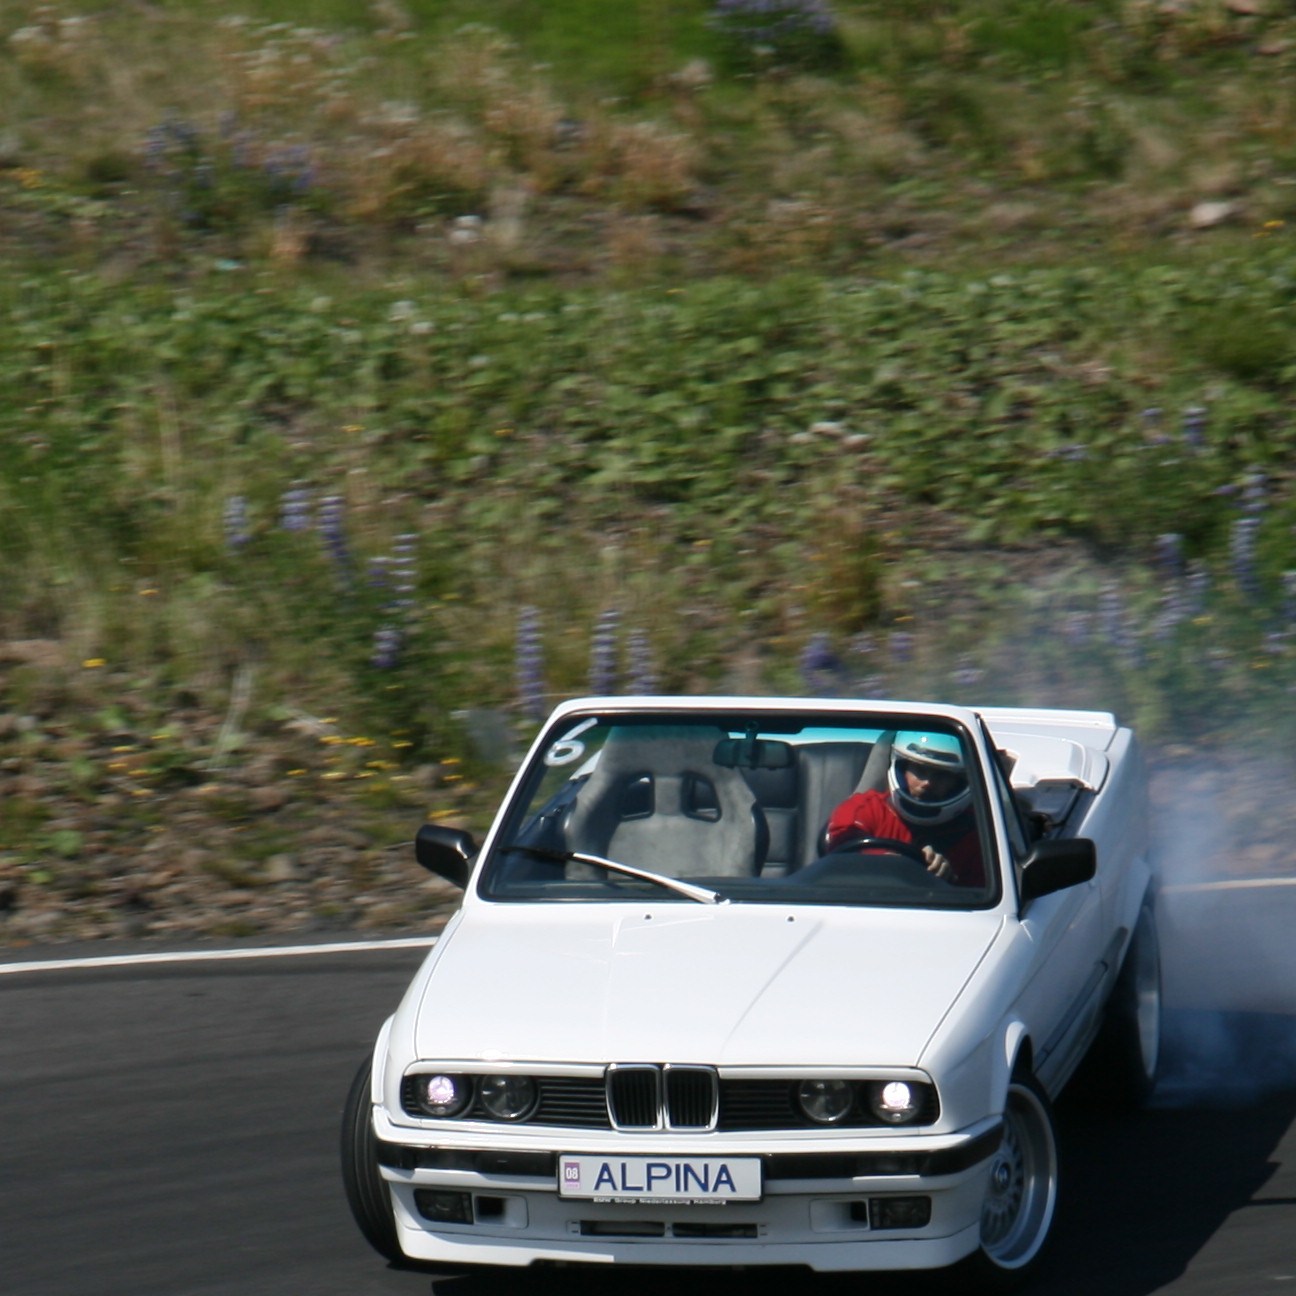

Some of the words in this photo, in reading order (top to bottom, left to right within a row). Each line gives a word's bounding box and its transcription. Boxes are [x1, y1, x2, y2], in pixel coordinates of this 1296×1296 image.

[544, 717, 598, 766] 6
[566, 1167, 578, 1179] 08
[594, 1162, 736, 1192] ALPINA
